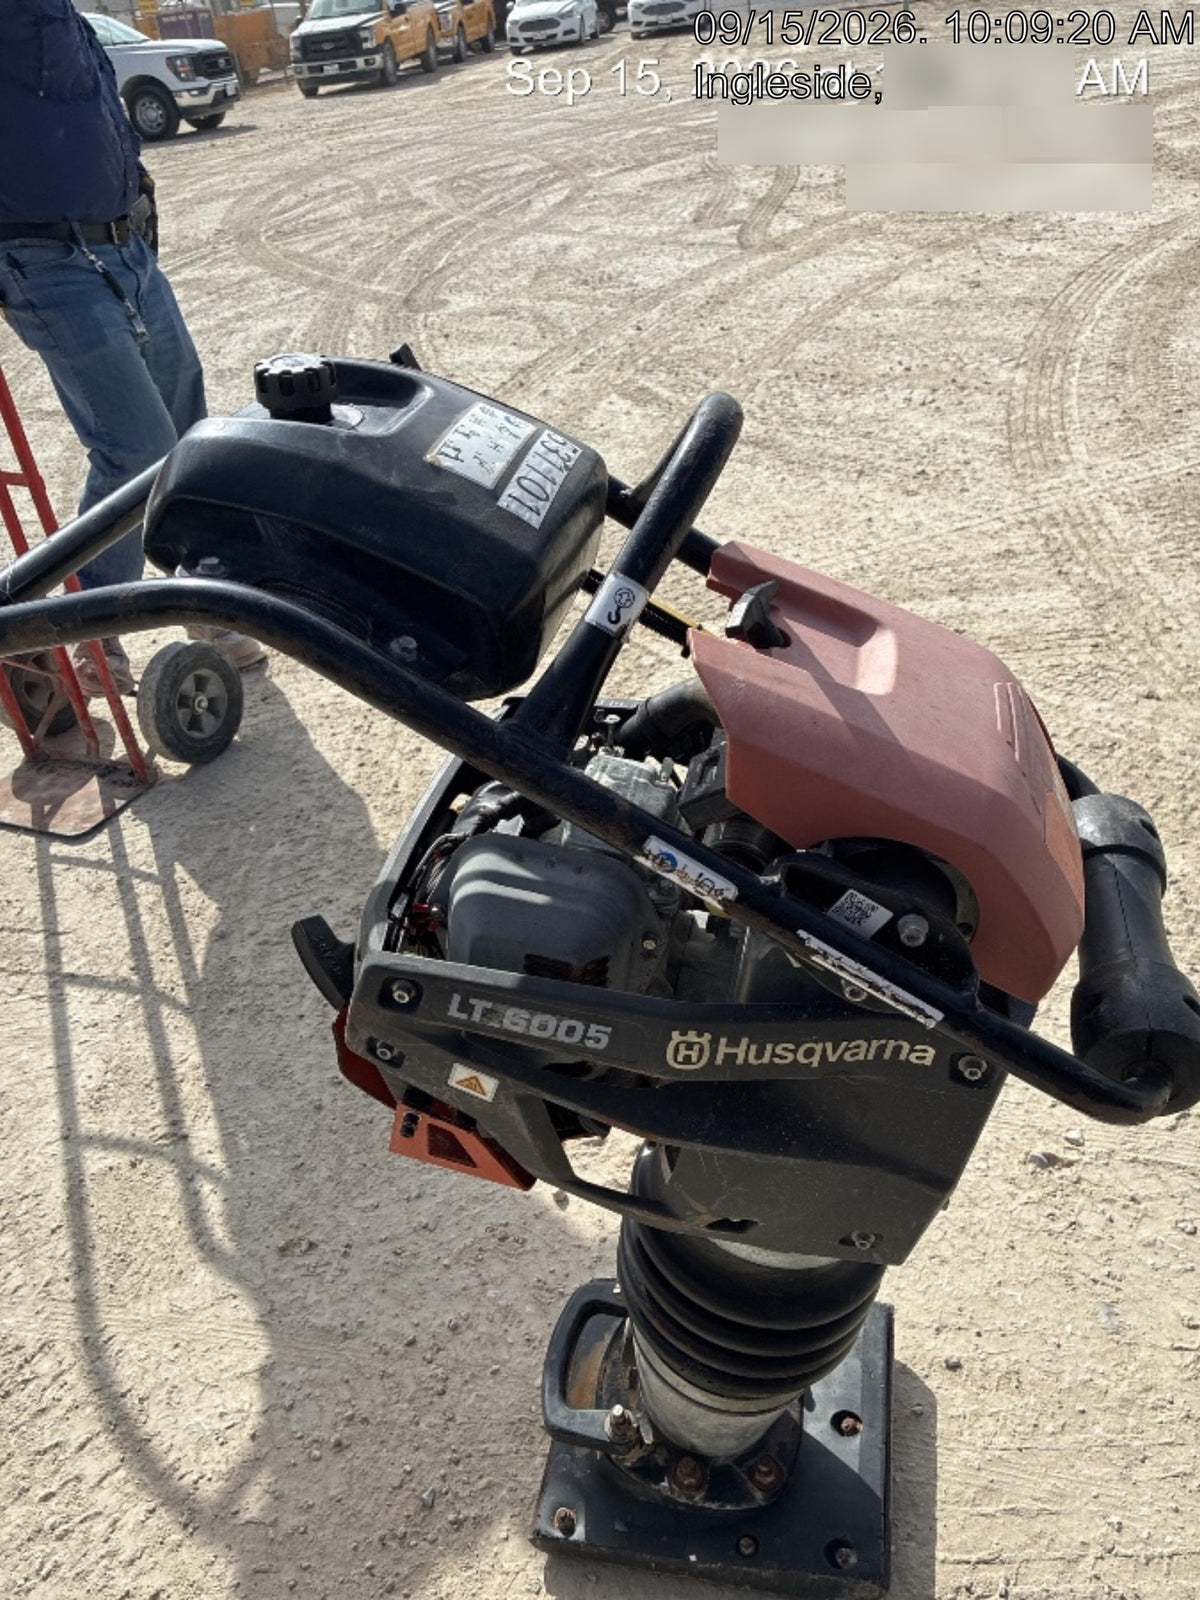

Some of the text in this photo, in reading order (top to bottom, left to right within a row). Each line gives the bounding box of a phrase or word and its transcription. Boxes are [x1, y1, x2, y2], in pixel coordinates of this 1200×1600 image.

[447, 992, 613, 1051] LT 6005
[714, 1036, 937, 1068] Husqvarna
